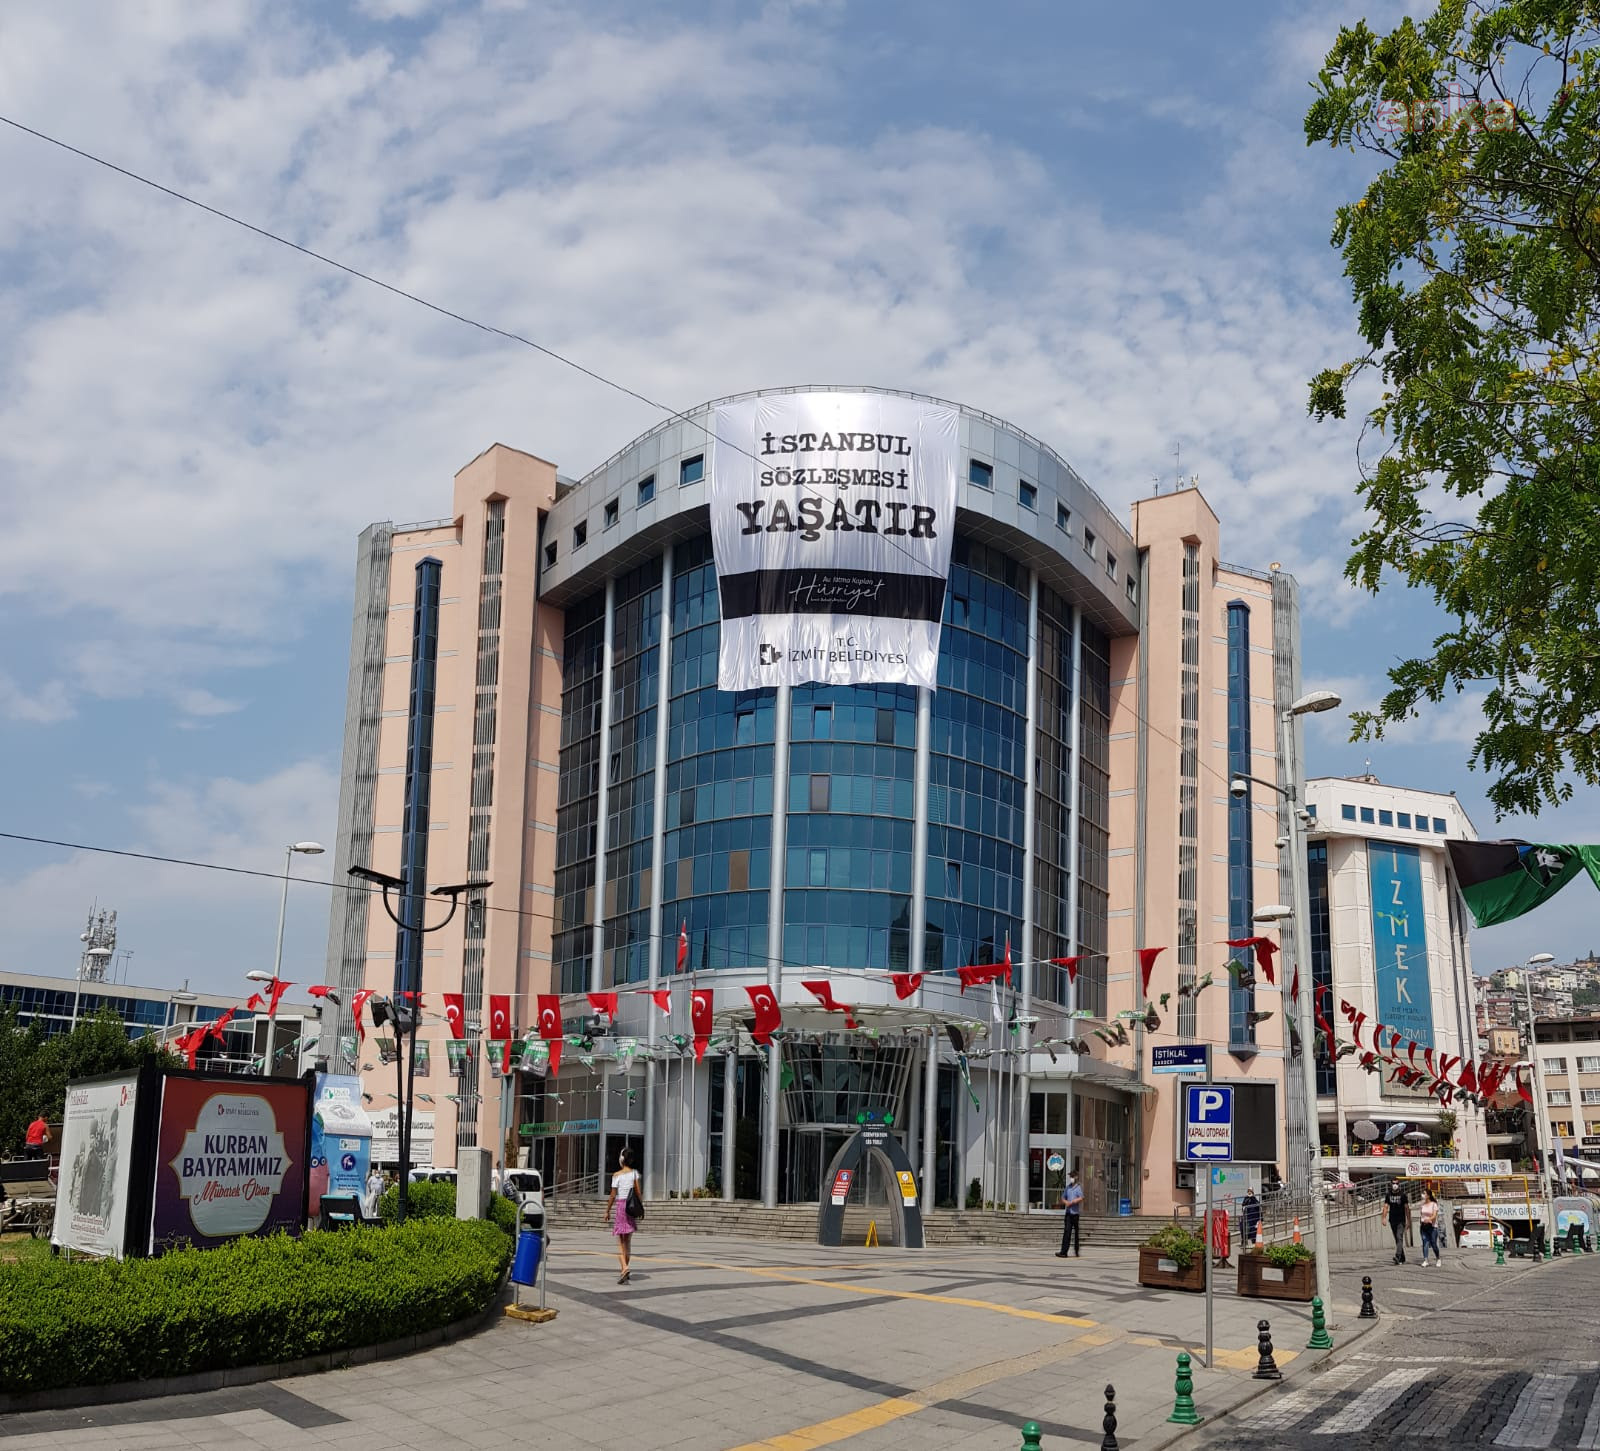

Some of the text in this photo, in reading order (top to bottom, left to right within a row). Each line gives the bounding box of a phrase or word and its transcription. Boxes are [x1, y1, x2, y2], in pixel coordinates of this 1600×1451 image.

[761, 432, 911, 456] İSTANBUL
[761, 467, 908, 490] SÖZLEŞMESİ
[736, 497, 937, 542] YAŞATIR
[789, 573, 885, 610] Hürriyet
[836, 637, 858, 647] T.C.
[788, 646, 908, 665] İZMİT BELEDİYESİ
[1155, 1049, 1188, 1059] İSTİKLAL
[1199, 1090, 1223, 1121] P
[1189, 1127, 1230, 1138] KAPALI OTOPARK
[204, 1135, 268, 1154] KURBAN
[182, 1157, 282, 1177] BAYRAMIMIZ
[1434, 1163, 1472, 1173] OTOPARK
[194, 1178, 270, 1205] Mübarek Olsun
[1487, 1207, 1518, 1216] TOPARK
